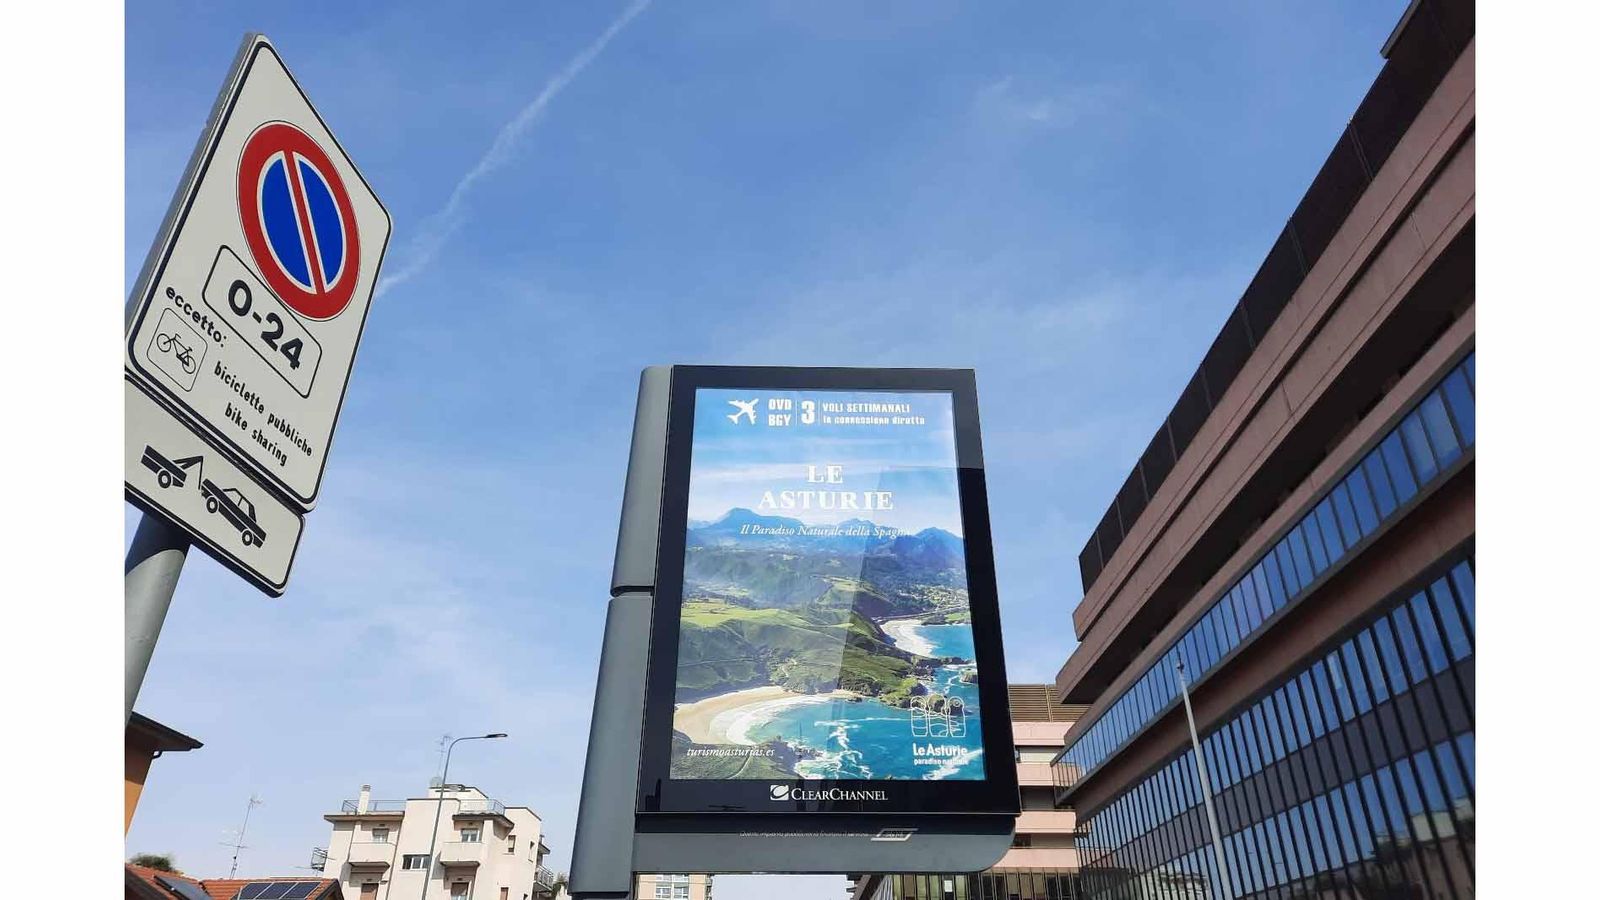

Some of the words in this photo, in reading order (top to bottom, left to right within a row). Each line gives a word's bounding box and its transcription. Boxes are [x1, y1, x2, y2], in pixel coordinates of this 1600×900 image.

[165, 286, 227, 348] eccetto:
[228, 279, 304, 370] 0-24
[213, 360, 265, 414] biciclette
[267, 412, 313, 457] pubbliche
[768, 398, 792, 411] OVD
[801, 400, 816, 424] 3
[822, 403, 844, 412] VOLI
[846, 403, 910, 413] SETTIMANALI
[768, 414, 792, 426] BGY
[224, 402, 248, 430] bike
[251, 427, 288, 467] sharing
[807, 465, 844, 484] LE
[757, 490, 894, 511] ASTURIE
[740, 524, 750, 535] Il
[751, 524, 795, 535] Paradiso
[797, 525, 844, 536] Naturale
[845, 526, 870, 536] della
[687, 747, 775, 757] turismoasturias.es
[912, 742, 925, 756] Le
[926, 743, 968, 756] Asturie
